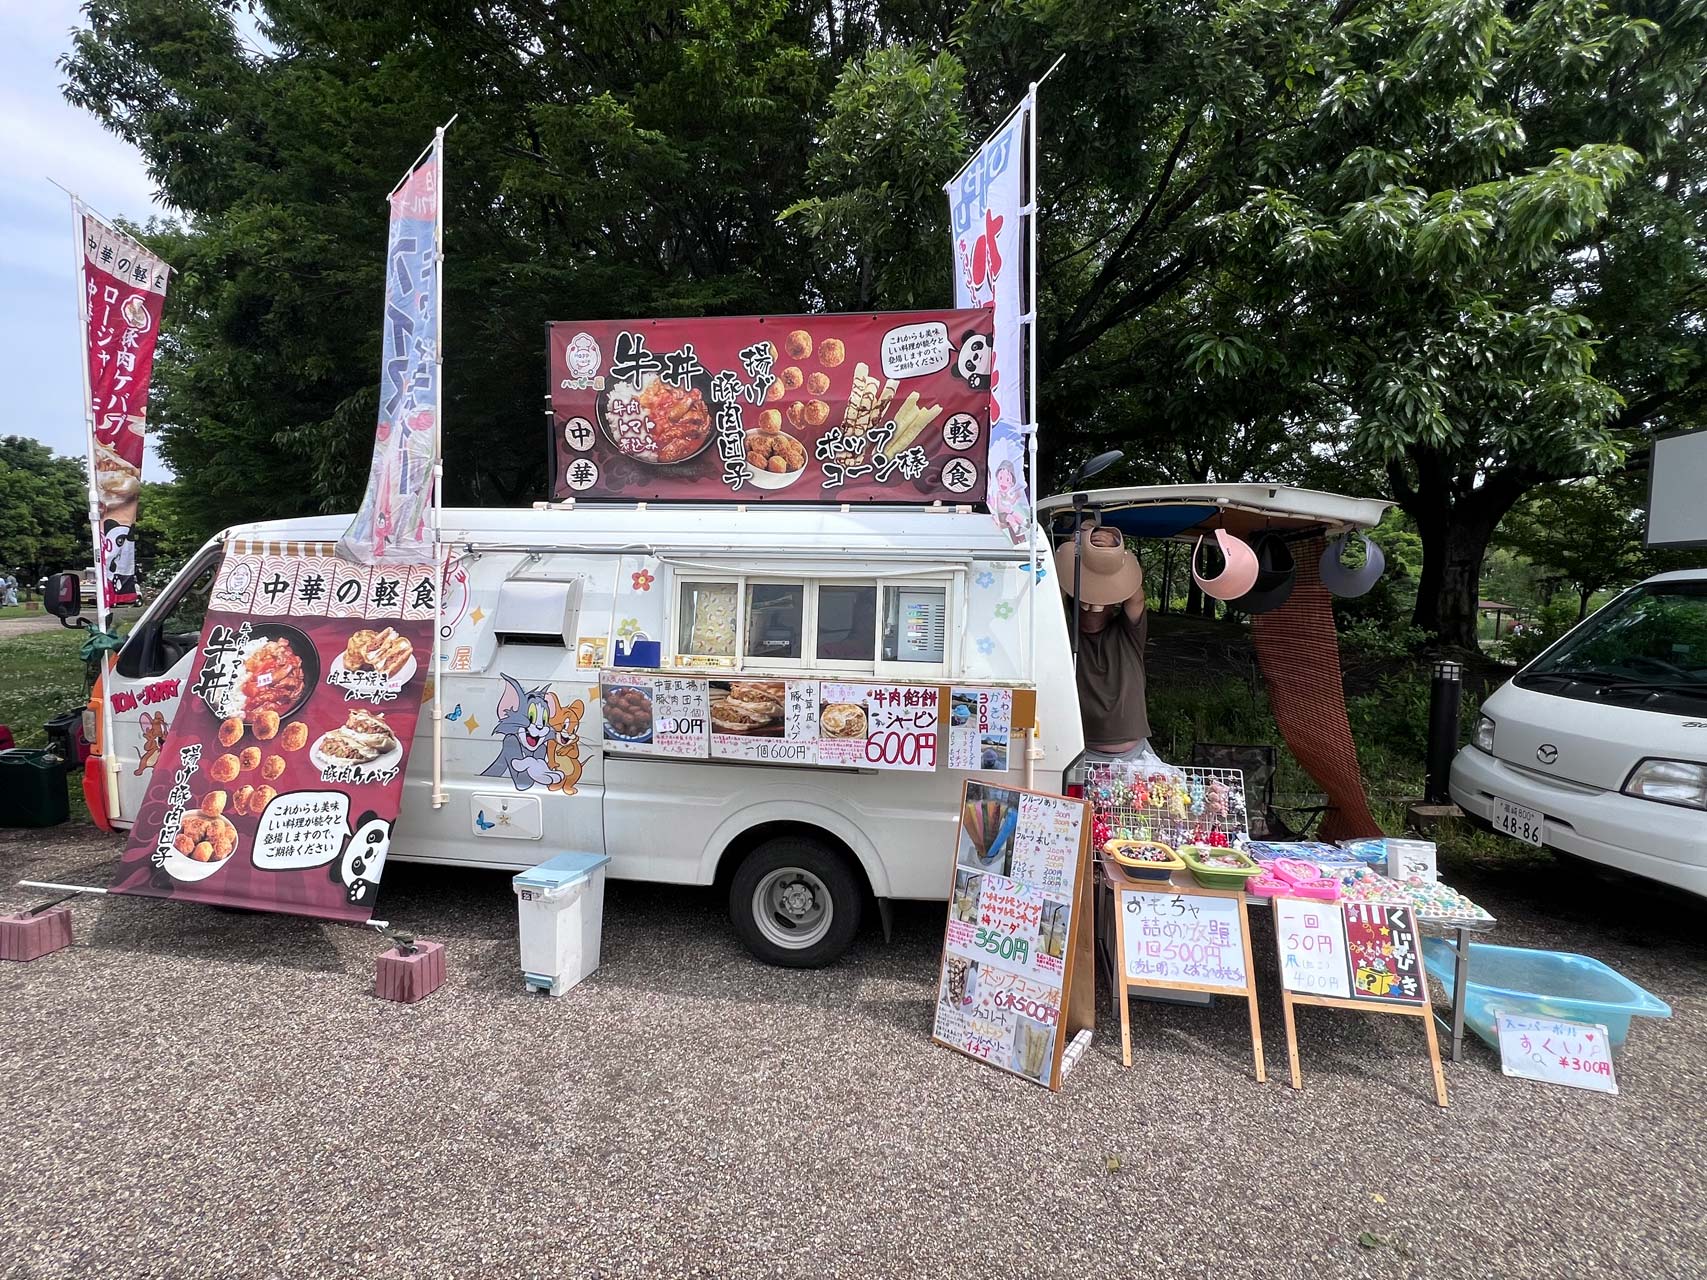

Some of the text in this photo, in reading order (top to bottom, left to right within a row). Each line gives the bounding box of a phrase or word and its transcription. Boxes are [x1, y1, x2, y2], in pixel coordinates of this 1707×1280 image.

[613, 400, 640, 417] 牛肉
[619, 417, 656, 436] トマト
[816, 421, 896, 460] ポップ
[821, 446, 929, 489] コーン棒
[262, 573, 436, 610] 中華の軽食
[111, 689, 138, 715] TOM
[655, 694, 703, 706] 豚肉団子
[660, 717, 703, 734] 00円
[864, 731, 937, 767] 600円
[321, 764, 400, 786] 豚肉ケバブ
[274, 800, 340, 816] これからも美味
[268, 815, 343, 831] しい料理が続々と
[1502, 814, 1539, 843] 48-86
[264, 829, 336, 845] 登場しますので、
[265, 844, 334, 858] ご期待ください
[1126, 895, 1200, 919] おもちゃ
[1283, 914, 1320, 929] 一回
[974, 927, 1030, 965] 350円
[1287, 933, 1333, 955] 50円
[1293, 971, 1339, 990] 400円
[1519, 1033, 1582, 1056] すくい
